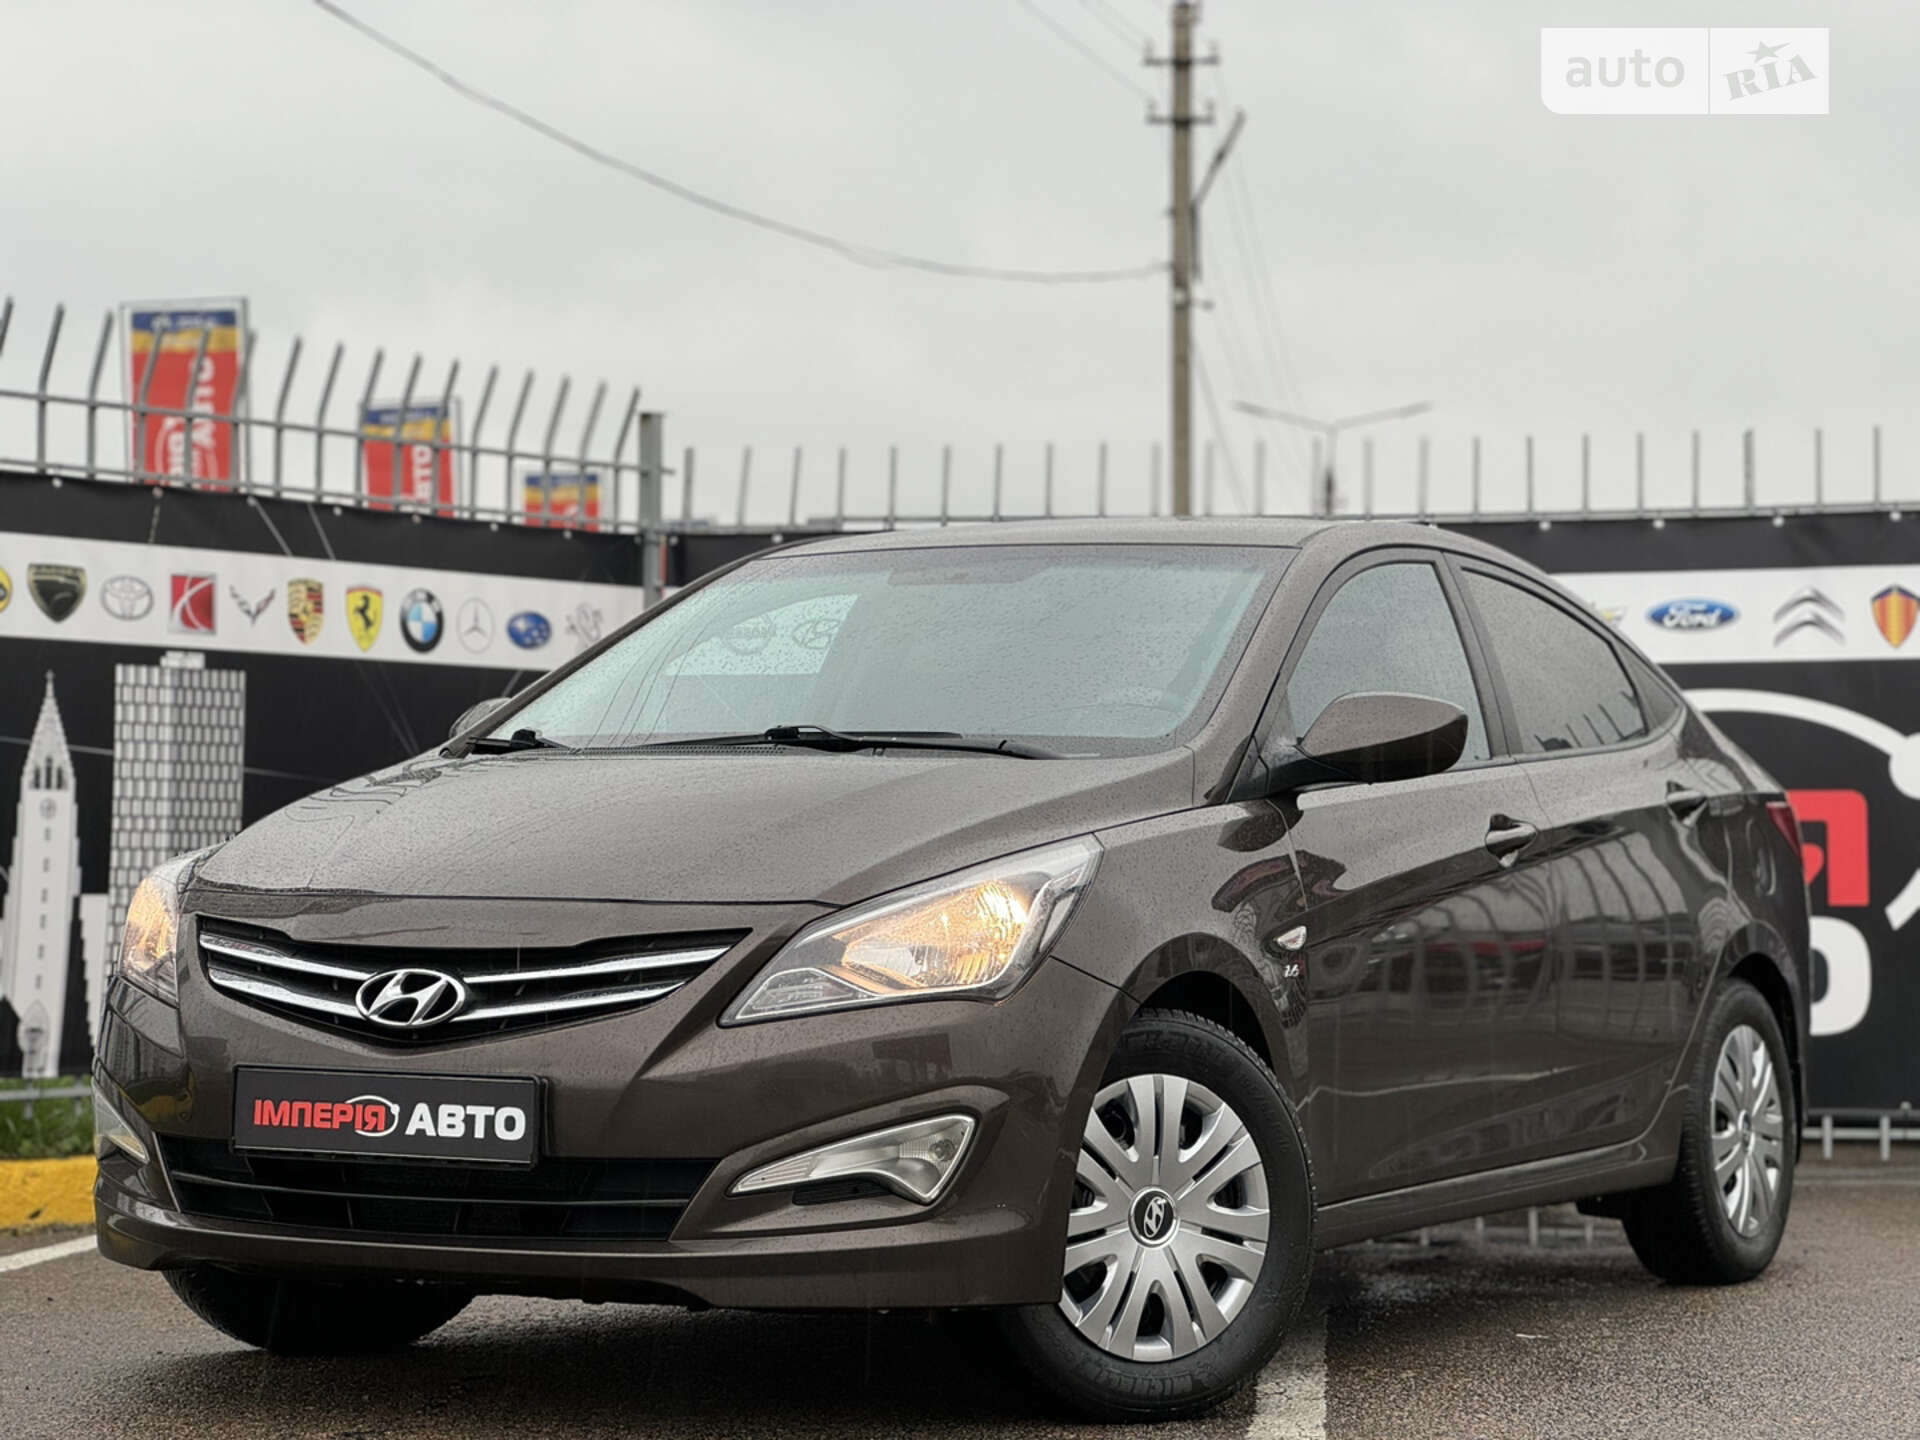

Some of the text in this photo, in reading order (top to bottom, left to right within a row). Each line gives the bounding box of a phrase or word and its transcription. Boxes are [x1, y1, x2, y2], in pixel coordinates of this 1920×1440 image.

[1663, 602, 1722, 628] Ford
[253, 1098, 527, 1141] ІМПЕРІЯ АВТО
